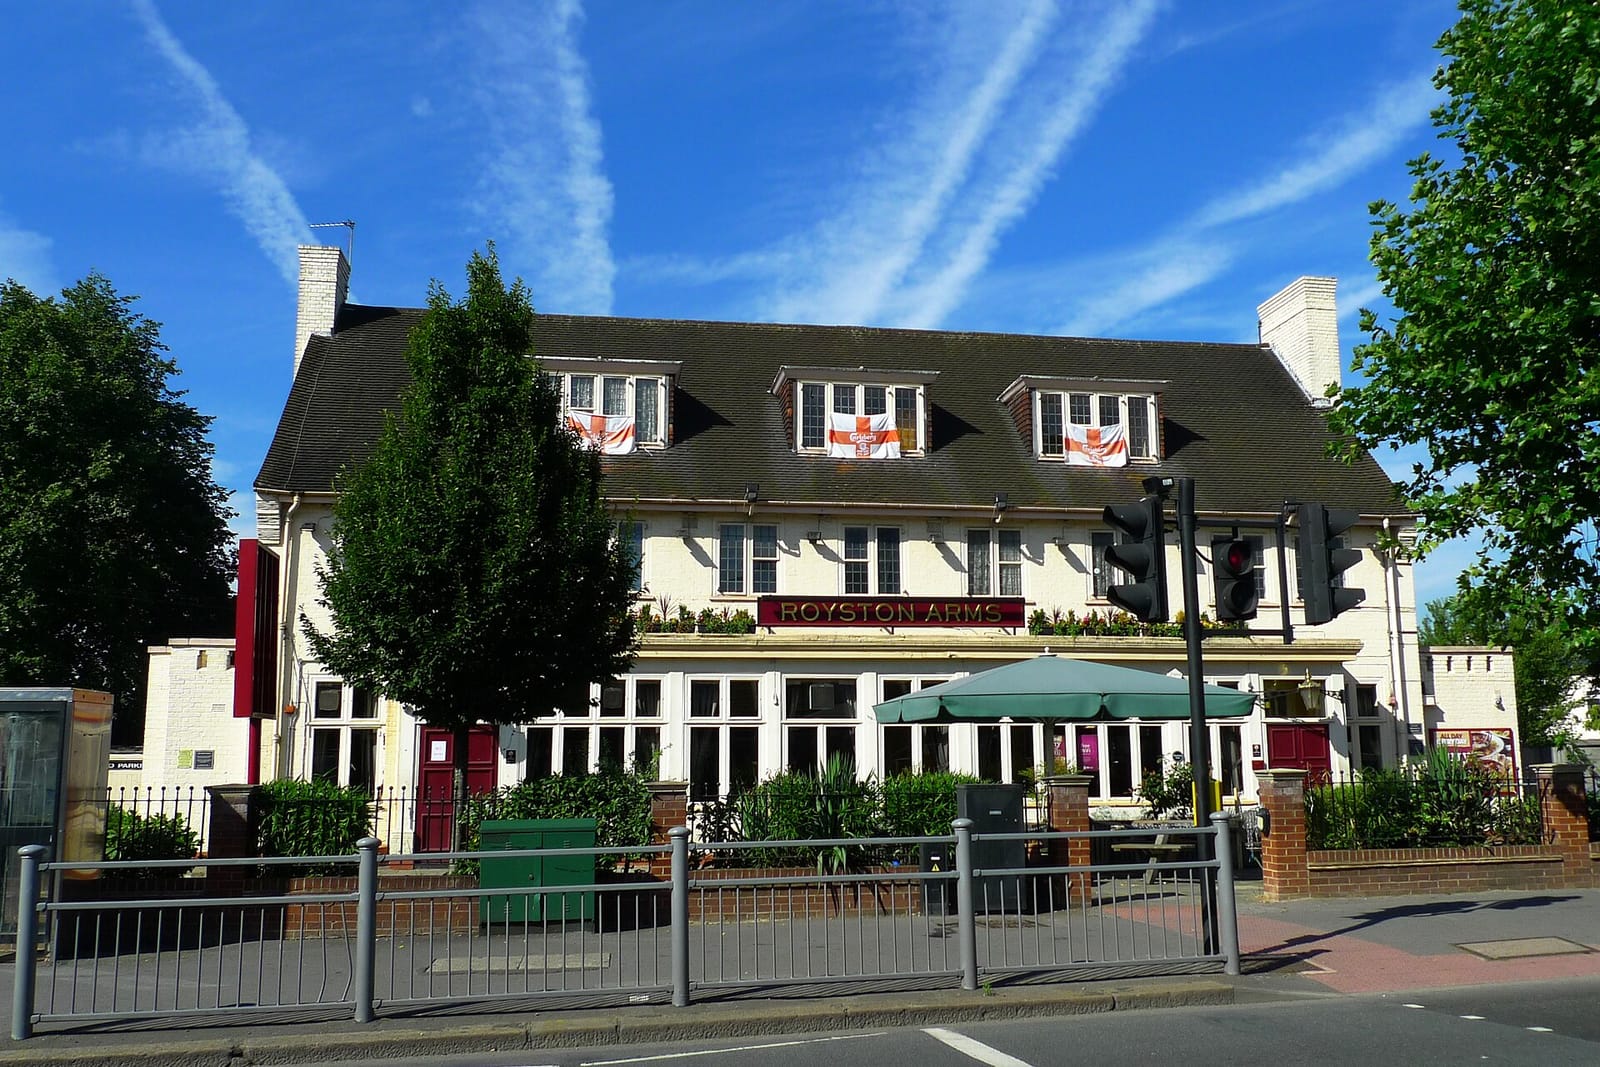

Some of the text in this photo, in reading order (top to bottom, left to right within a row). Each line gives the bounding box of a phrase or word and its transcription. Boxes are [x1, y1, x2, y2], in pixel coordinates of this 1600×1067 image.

[849, 432, 877, 442] Carlsberg
[780, 602, 1002, 622] ROYSTON ARMS
